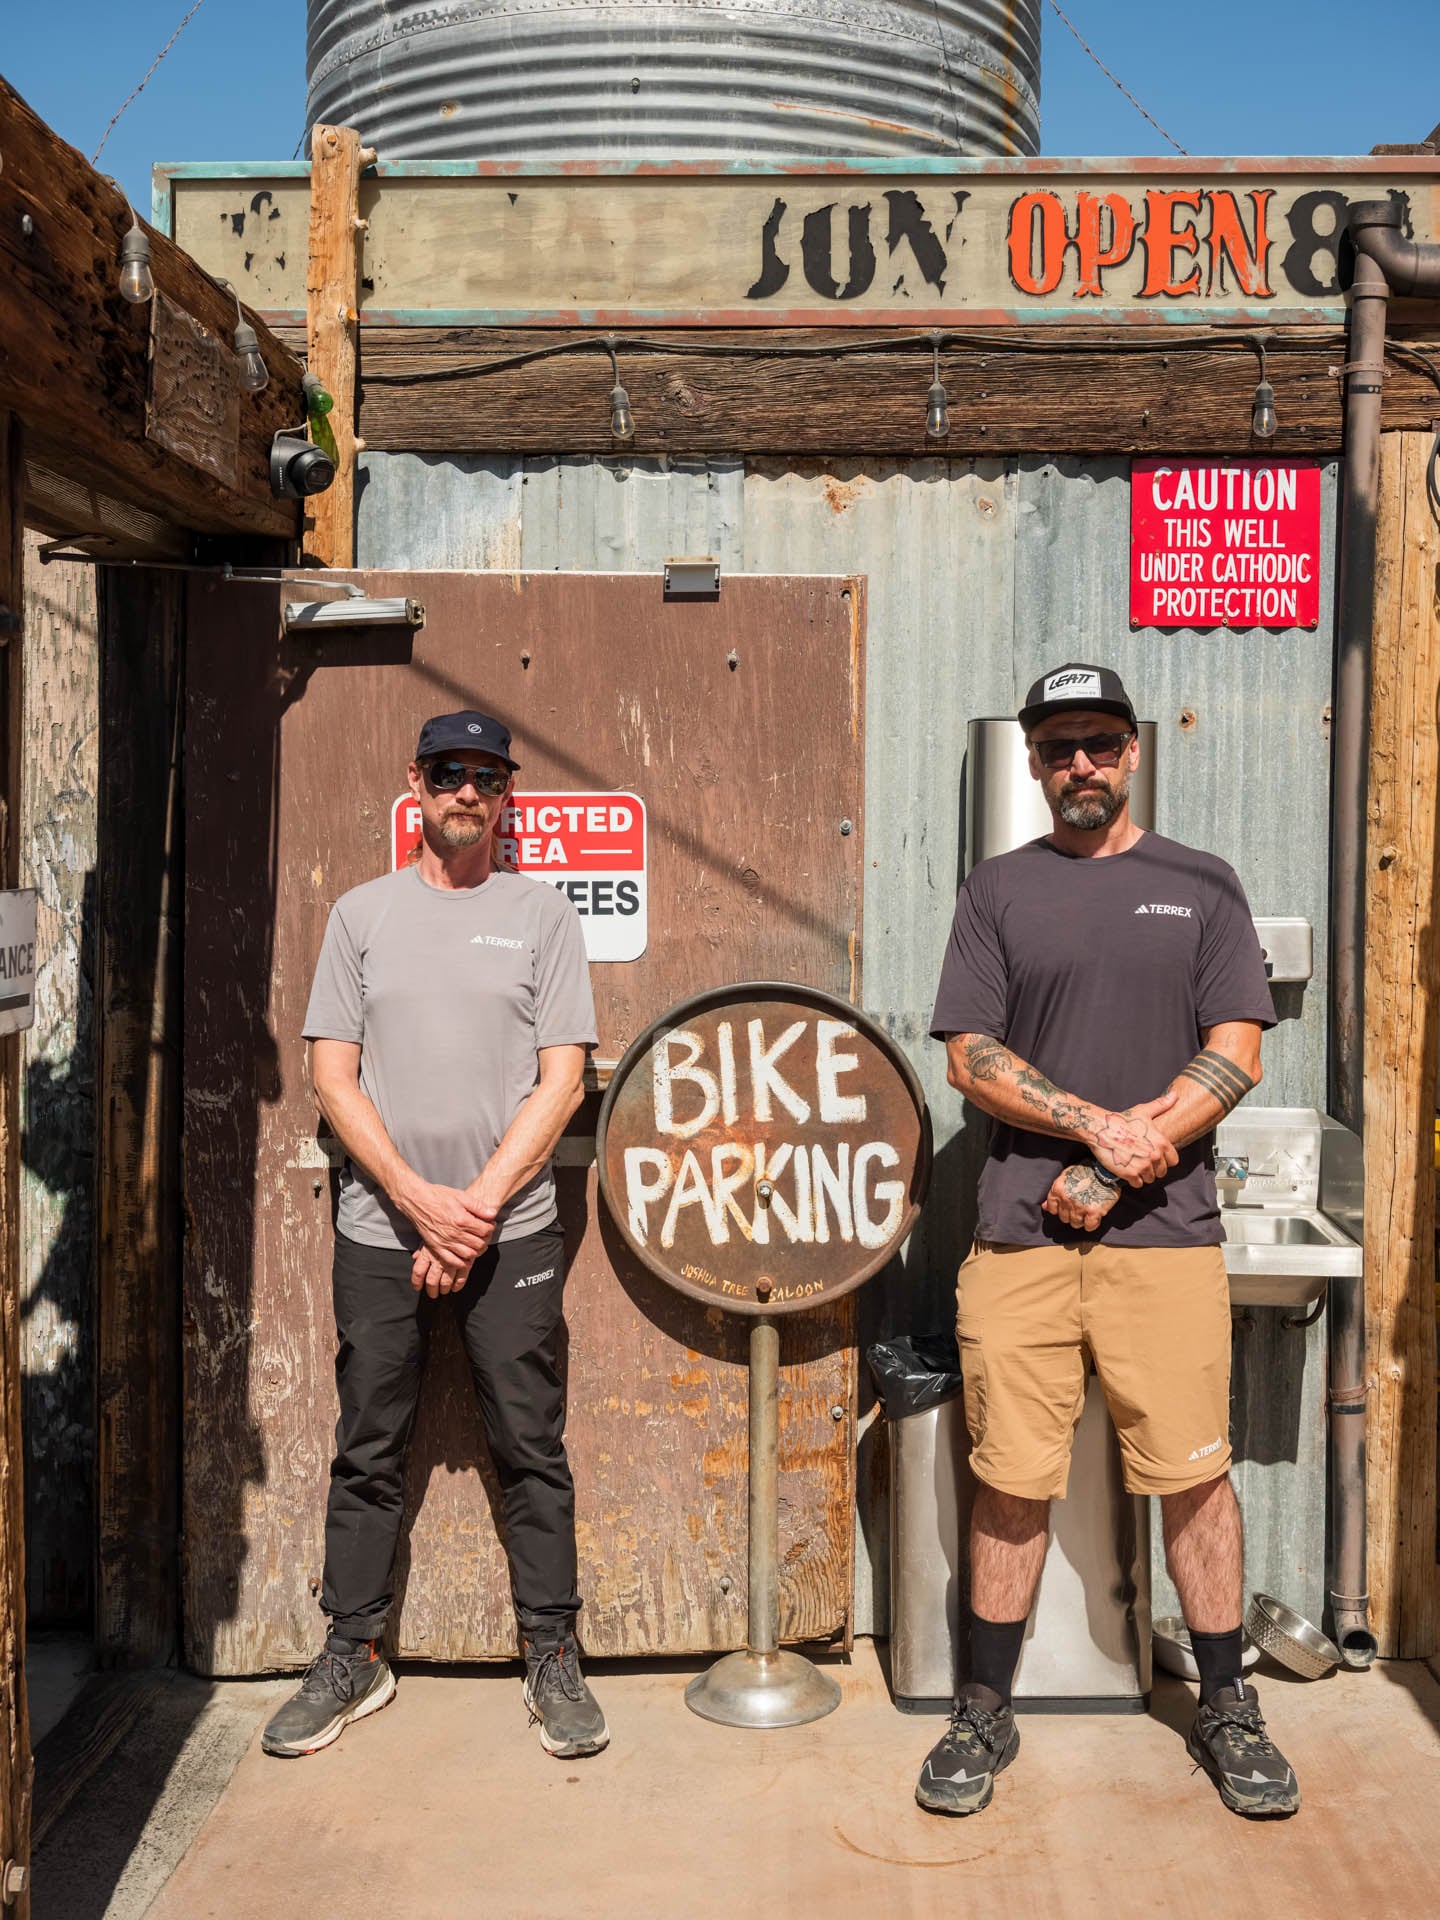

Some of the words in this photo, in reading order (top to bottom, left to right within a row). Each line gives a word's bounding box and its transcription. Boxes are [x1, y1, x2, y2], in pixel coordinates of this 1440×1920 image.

[1007, 189, 1276, 298] OPEN
[1152, 467, 1297, 511] CAUTION
[1164, 518, 1212, 548] THIS
[1224, 519, 1286, 548] WELL
[1140, 553, 1204, 582] UNDER
[1212, 553, 1312, 583] CATHODIC
[1153, 587, 1297, 618] PROTECTION
[1149, 904, 1192, 918] TERREX
[485, 936, 525, 949] TERREX
[652, 1018, 867, 1139] BIKE
[624, 1141, 905, 1249] PARKING
[680, 1263, 717, 1286] JOSHUA
[722, 1279, 749, 1297] TREE
[769, 1279, 825, 1305] SALOON
